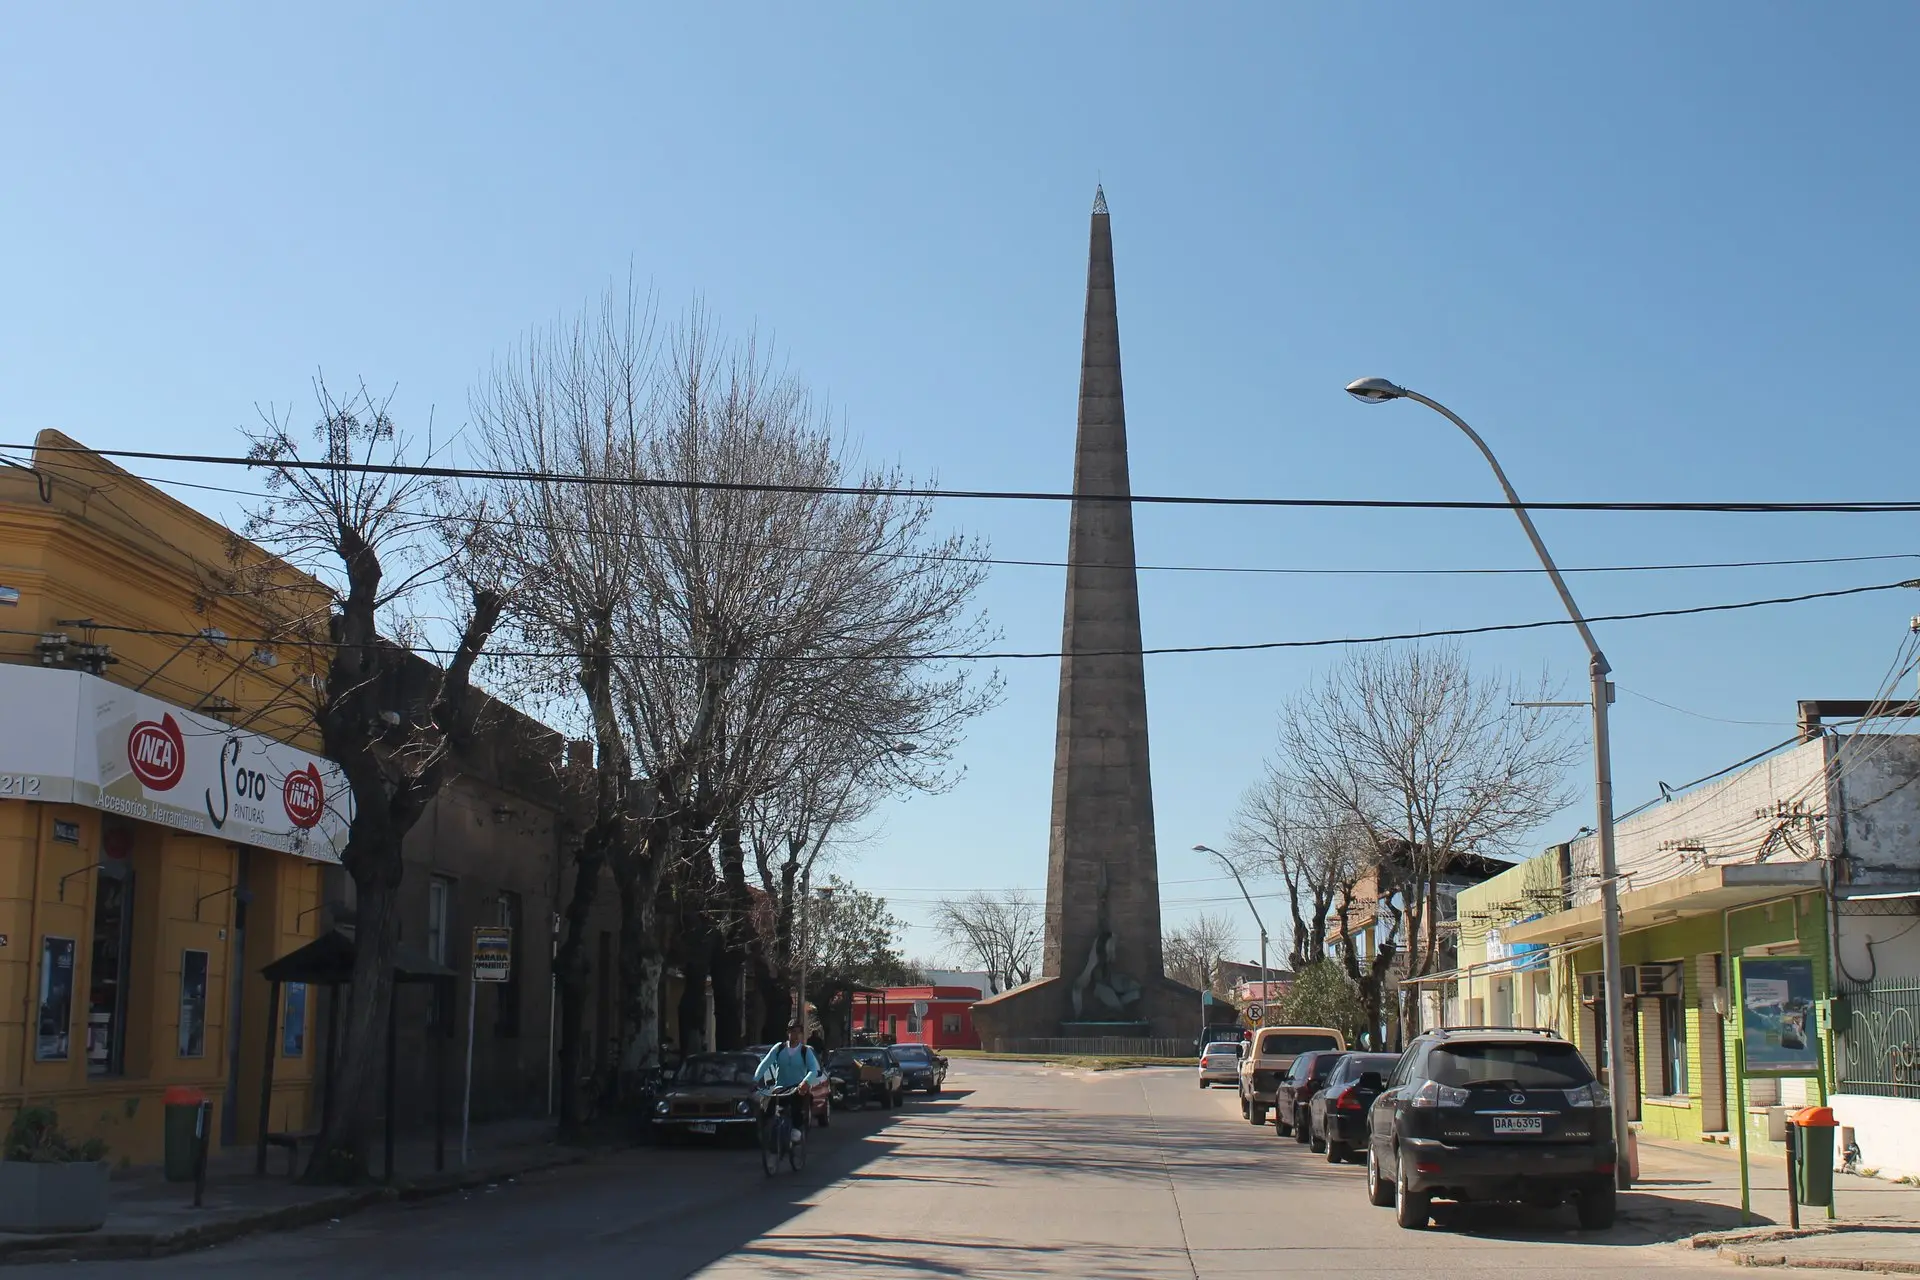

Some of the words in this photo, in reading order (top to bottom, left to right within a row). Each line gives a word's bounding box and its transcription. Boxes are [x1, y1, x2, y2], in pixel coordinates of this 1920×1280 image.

[137, 733, 172, 769] INCA
[289, 781, 315, 811] INCA
[233, 803, 265, 825] PINTURAS
[1494, 1119, 1513, 1128] DAA
[1516, 1118, 1541, 1128] 6395
